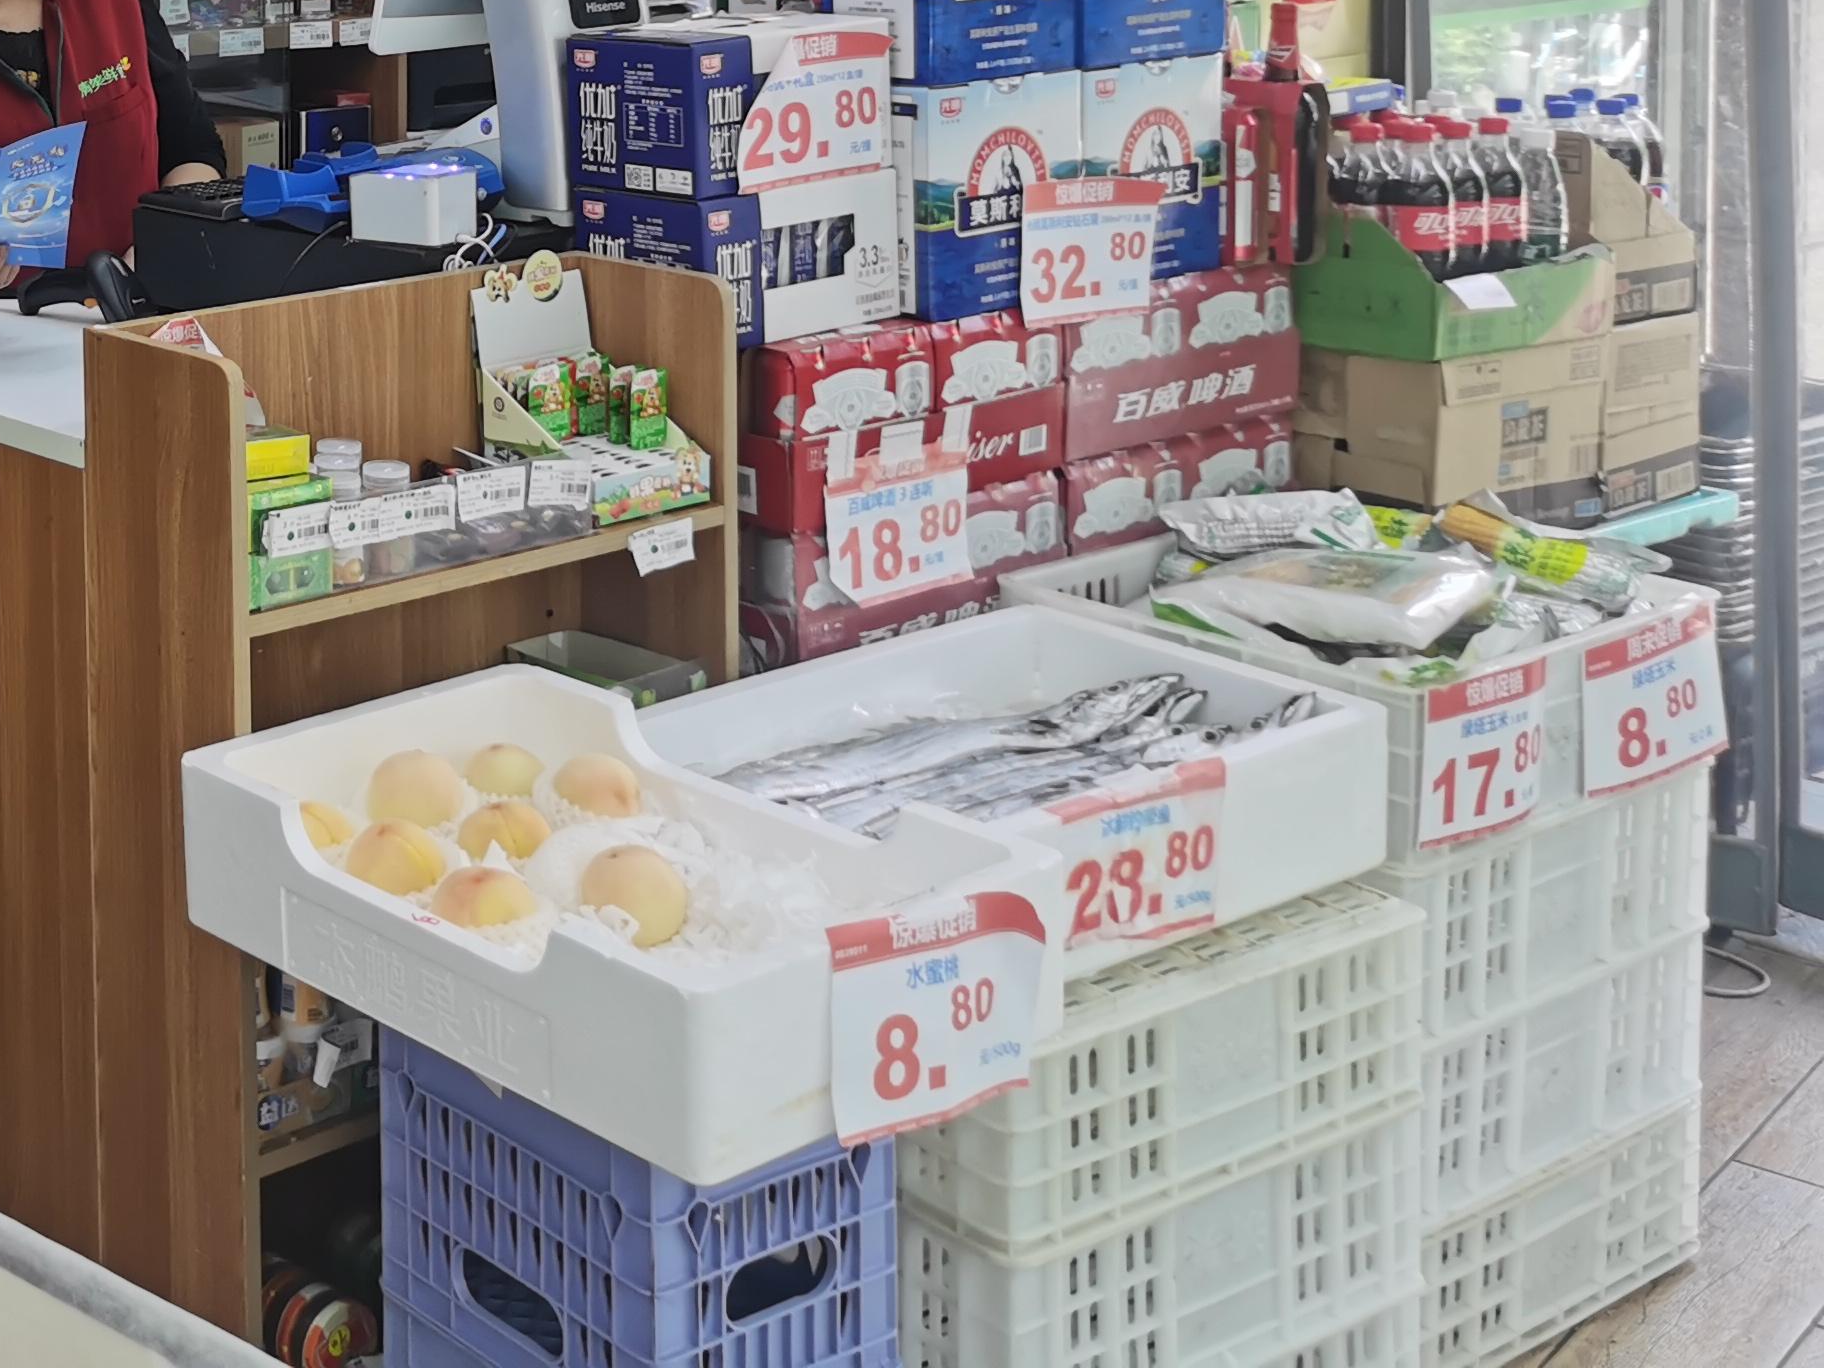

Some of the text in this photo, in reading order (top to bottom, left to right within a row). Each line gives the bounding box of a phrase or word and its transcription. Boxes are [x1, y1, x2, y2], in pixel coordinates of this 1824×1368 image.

[586, 0, 626, 14] Hisense
[1056, 181, 1114, 205] 惊爆促销
[1030, 230, 1146, 304] 32.80
[1112, 363, 1257, 425] 百威啤酒
[839, 499, 962, 590] 18.80
[1618, 678, 1697, 768] 8.80
[1433, 724, 1541, 825] 17.80
[906, 954, 959, 989] 水蜜桃
[873, 977, 994, 1101] 8.80
